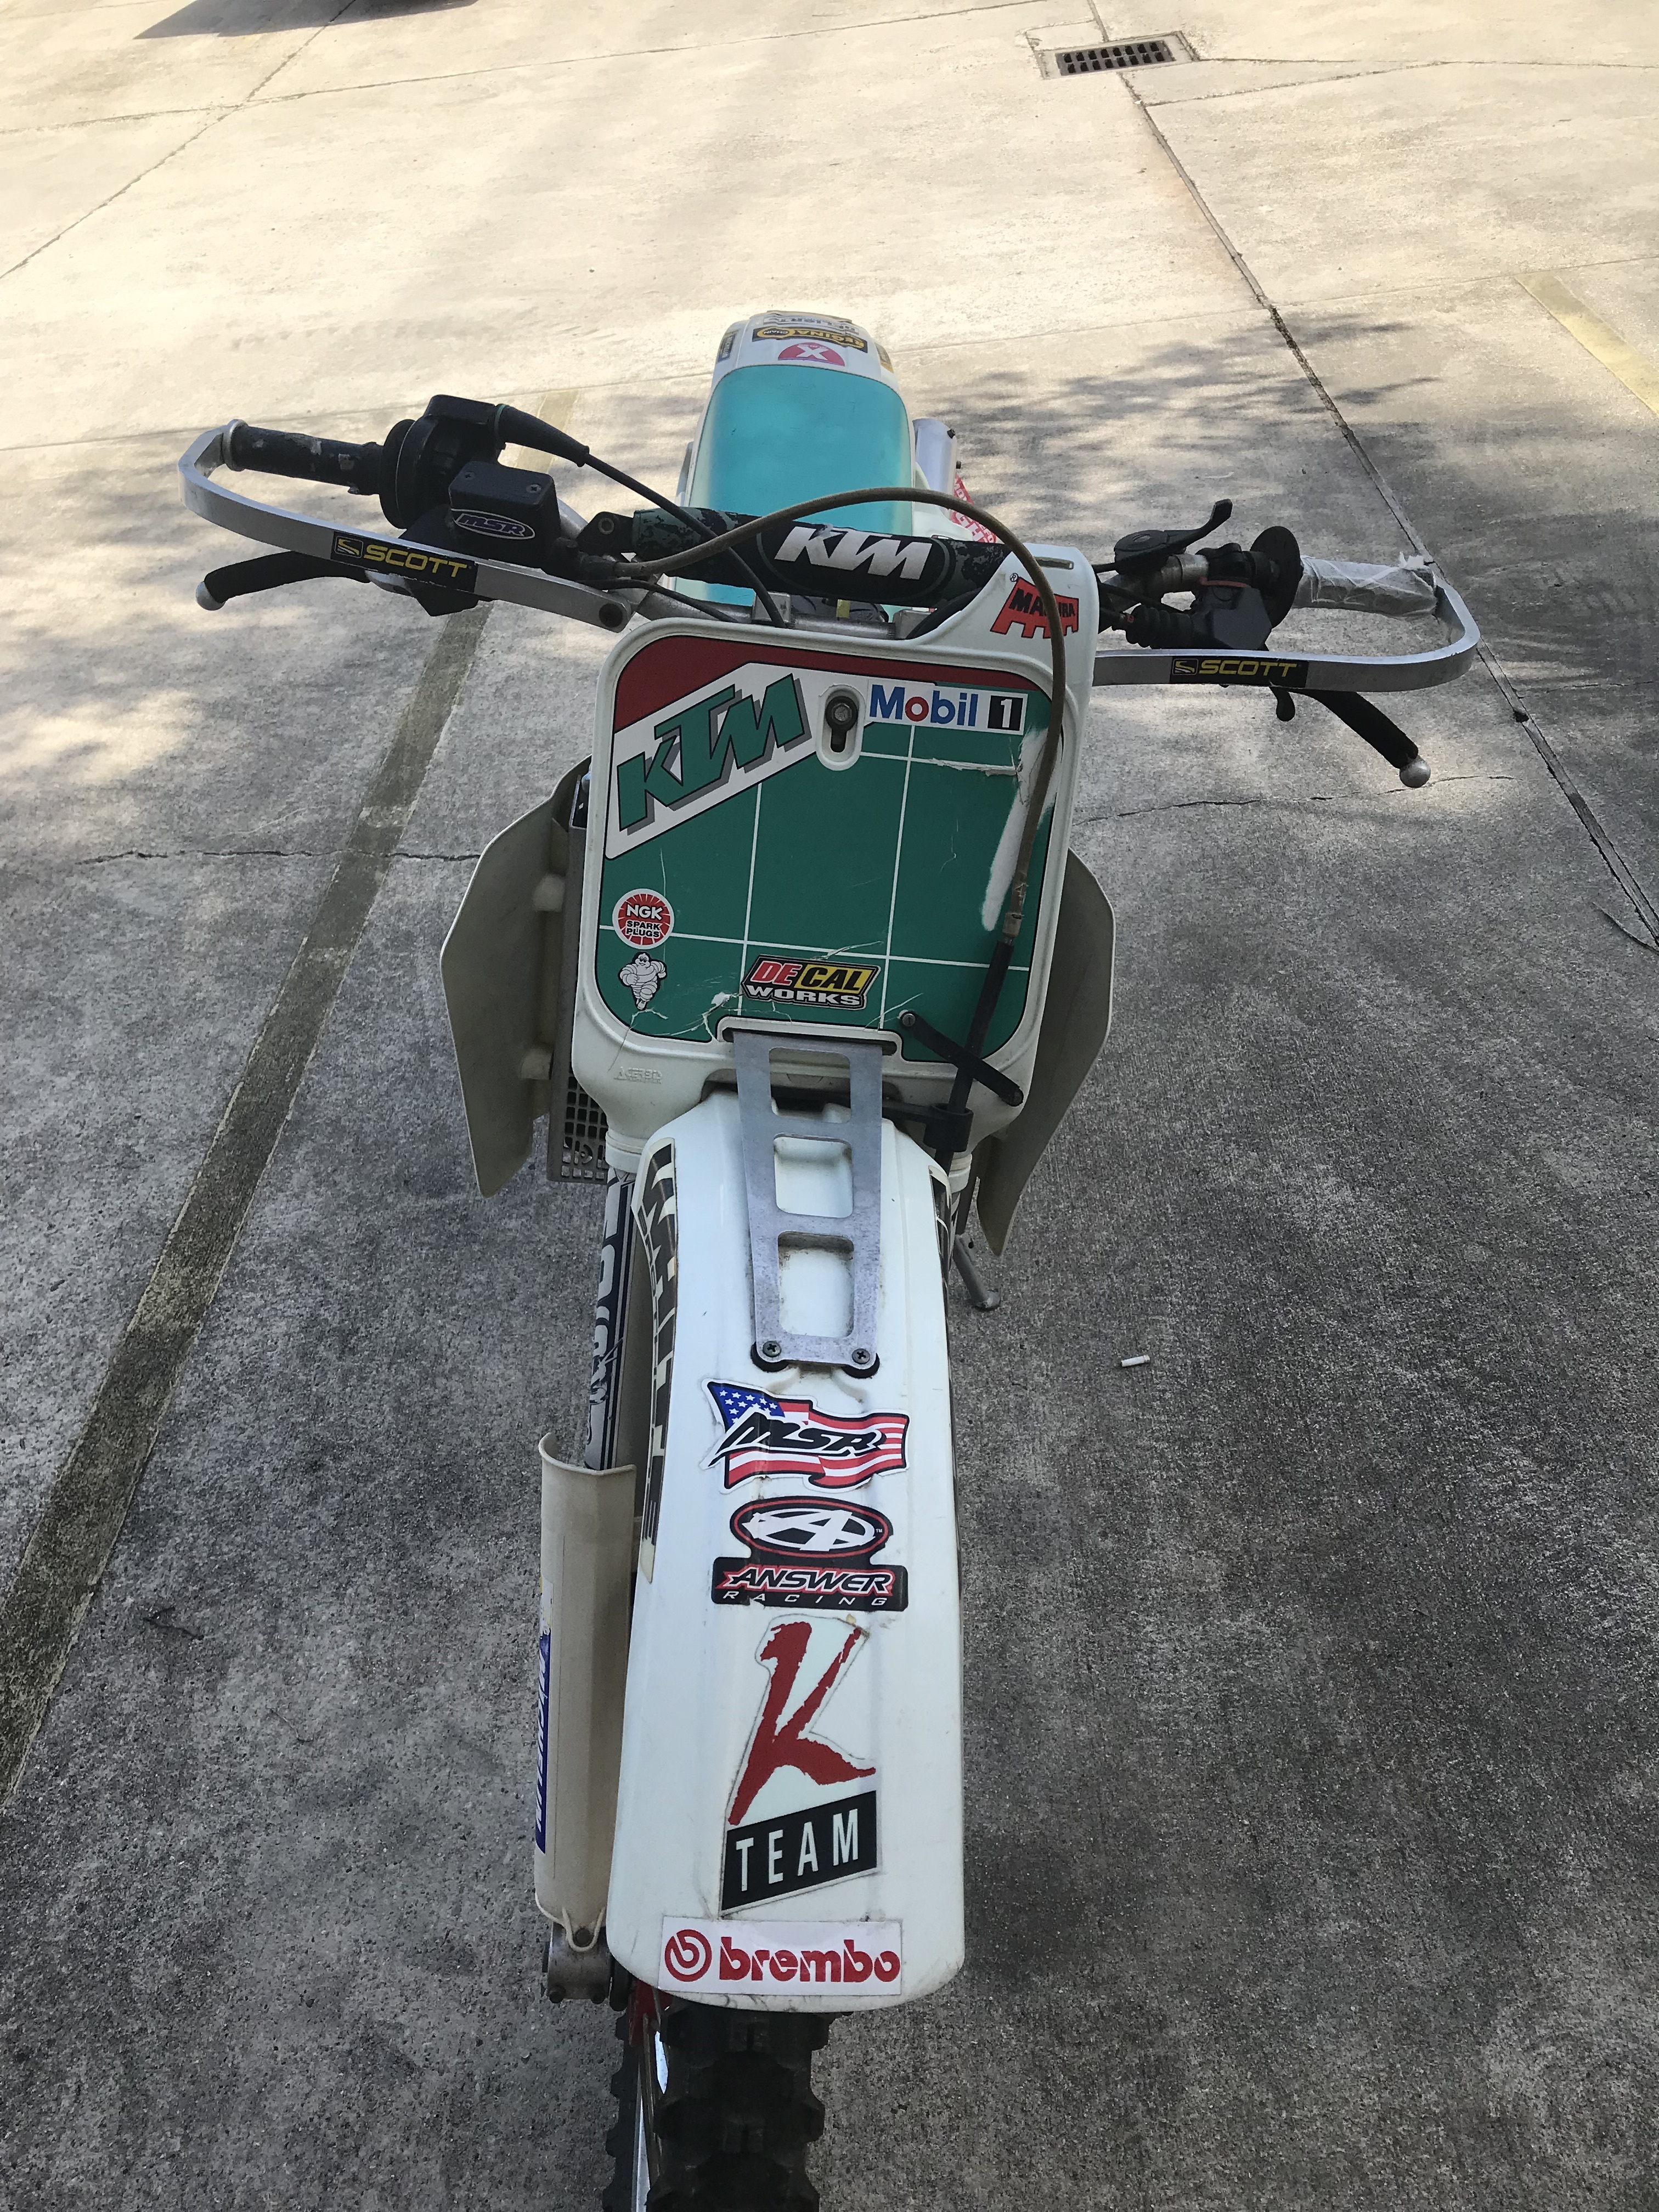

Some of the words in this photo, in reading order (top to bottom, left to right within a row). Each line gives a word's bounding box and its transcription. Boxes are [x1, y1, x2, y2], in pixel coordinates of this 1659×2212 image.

[795, 330, 865, 347] REGINA
[455, 514, 525, 537] MSR
[363, 543, 467, 578] SCOTT
[774, 526, 933, 579] KTM
[1008, 588, 1076, 618] MARA
[1199, 659, 1298, 677] SCOTT
[870, 684, 978, 727] Mobil
[617, 673, 811, 835] KTM
[627, 904, 663, 921] NGK
[627, 920, 661, 930] SPARK
[626, 928, 660, 938] PLUGS
[746, 985, 860, 1006] WORKS
[708, 1412, 887, 1466] MSR
[720, 1565, 896, 1595] ANSWER
[723, 1590, 887, 1606] RACING
[736, 1808, 859, 1892] TEAM
[719, 1936, 901, 1983] brembo
